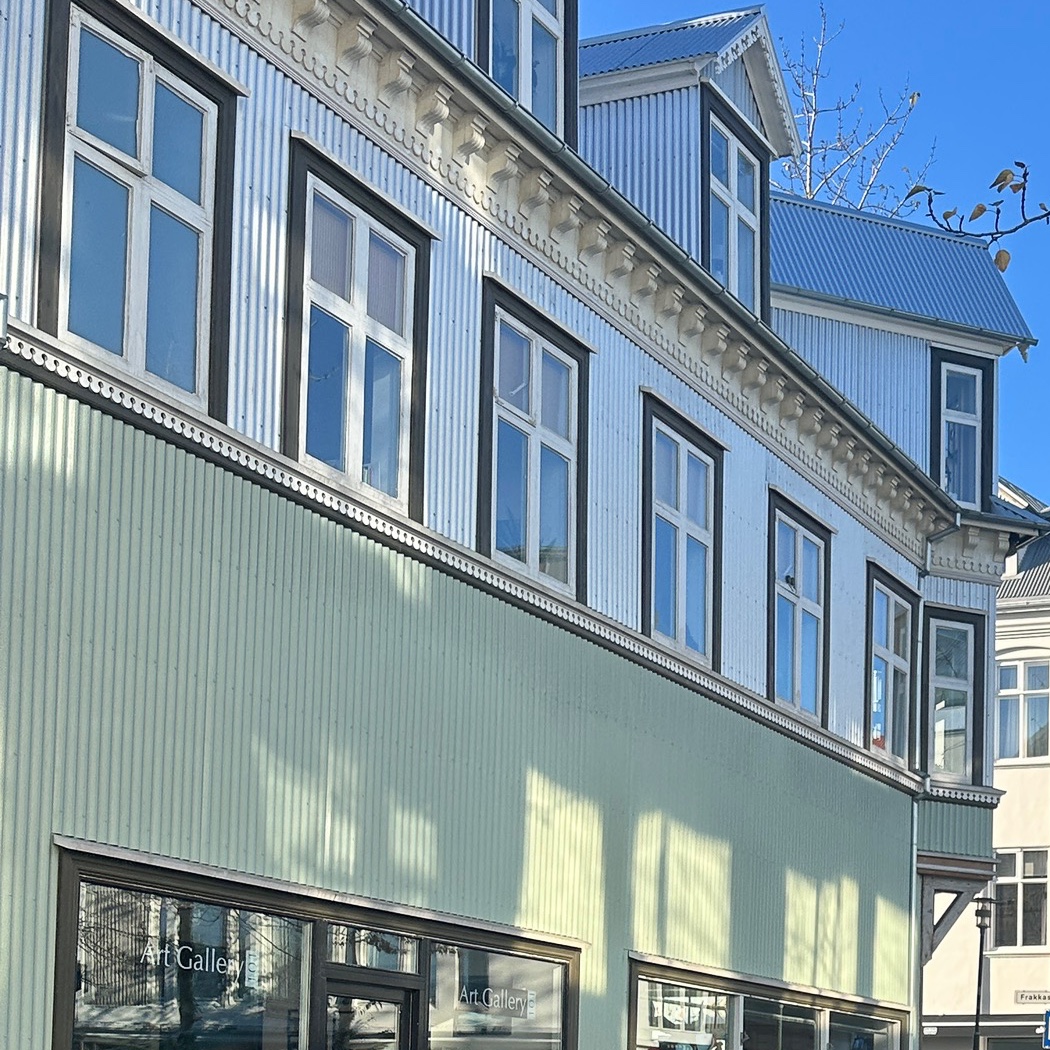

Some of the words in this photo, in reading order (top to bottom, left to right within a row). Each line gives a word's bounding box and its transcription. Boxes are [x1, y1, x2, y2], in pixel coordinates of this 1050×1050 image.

[140, 940, 170, 967] Art
[177, 945, 244, 984] Gallery
[460, 985, 479, 1006] Art
[482, 987, 527, 1016] Gallery
